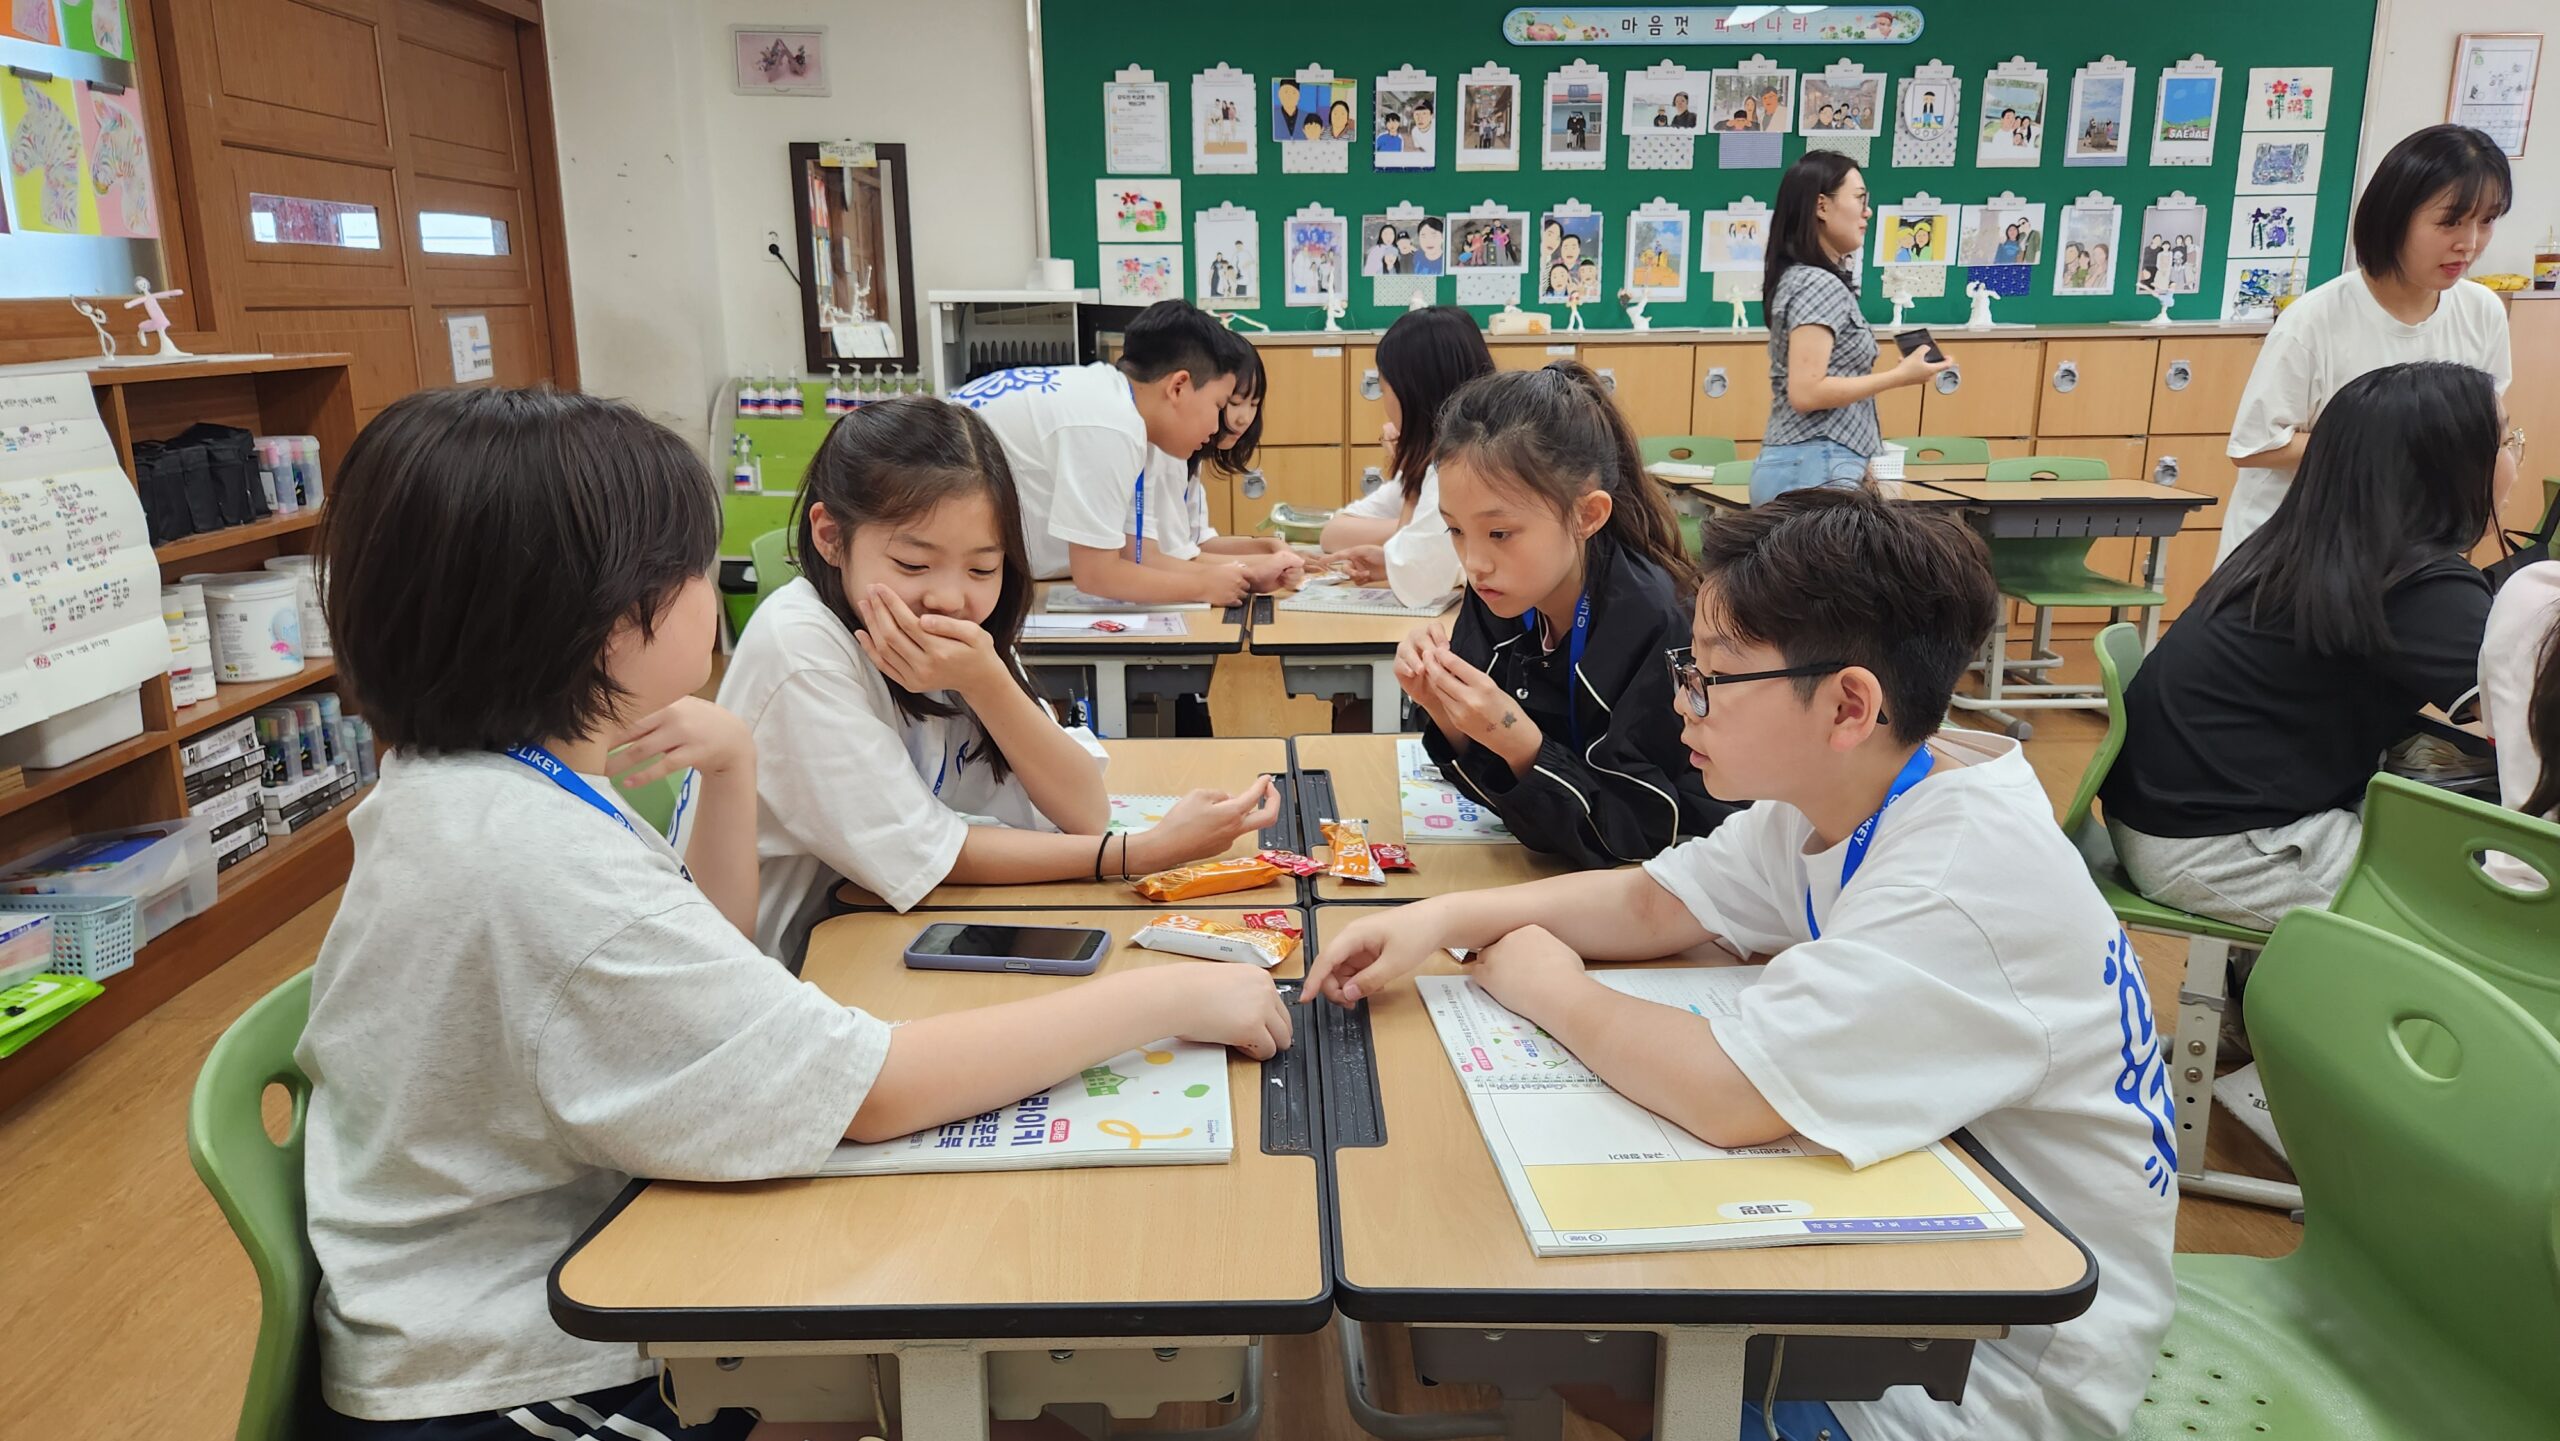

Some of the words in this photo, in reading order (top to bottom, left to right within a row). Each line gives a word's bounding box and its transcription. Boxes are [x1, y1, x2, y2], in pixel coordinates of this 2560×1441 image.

[1621, 15, 1689, 36] 마음껏
[518, 746, 564, 776] LIKEY
[1010, 1096, 1050, 1146] 라이키
[1738, 1204, 1793, 1217] 그룹명
